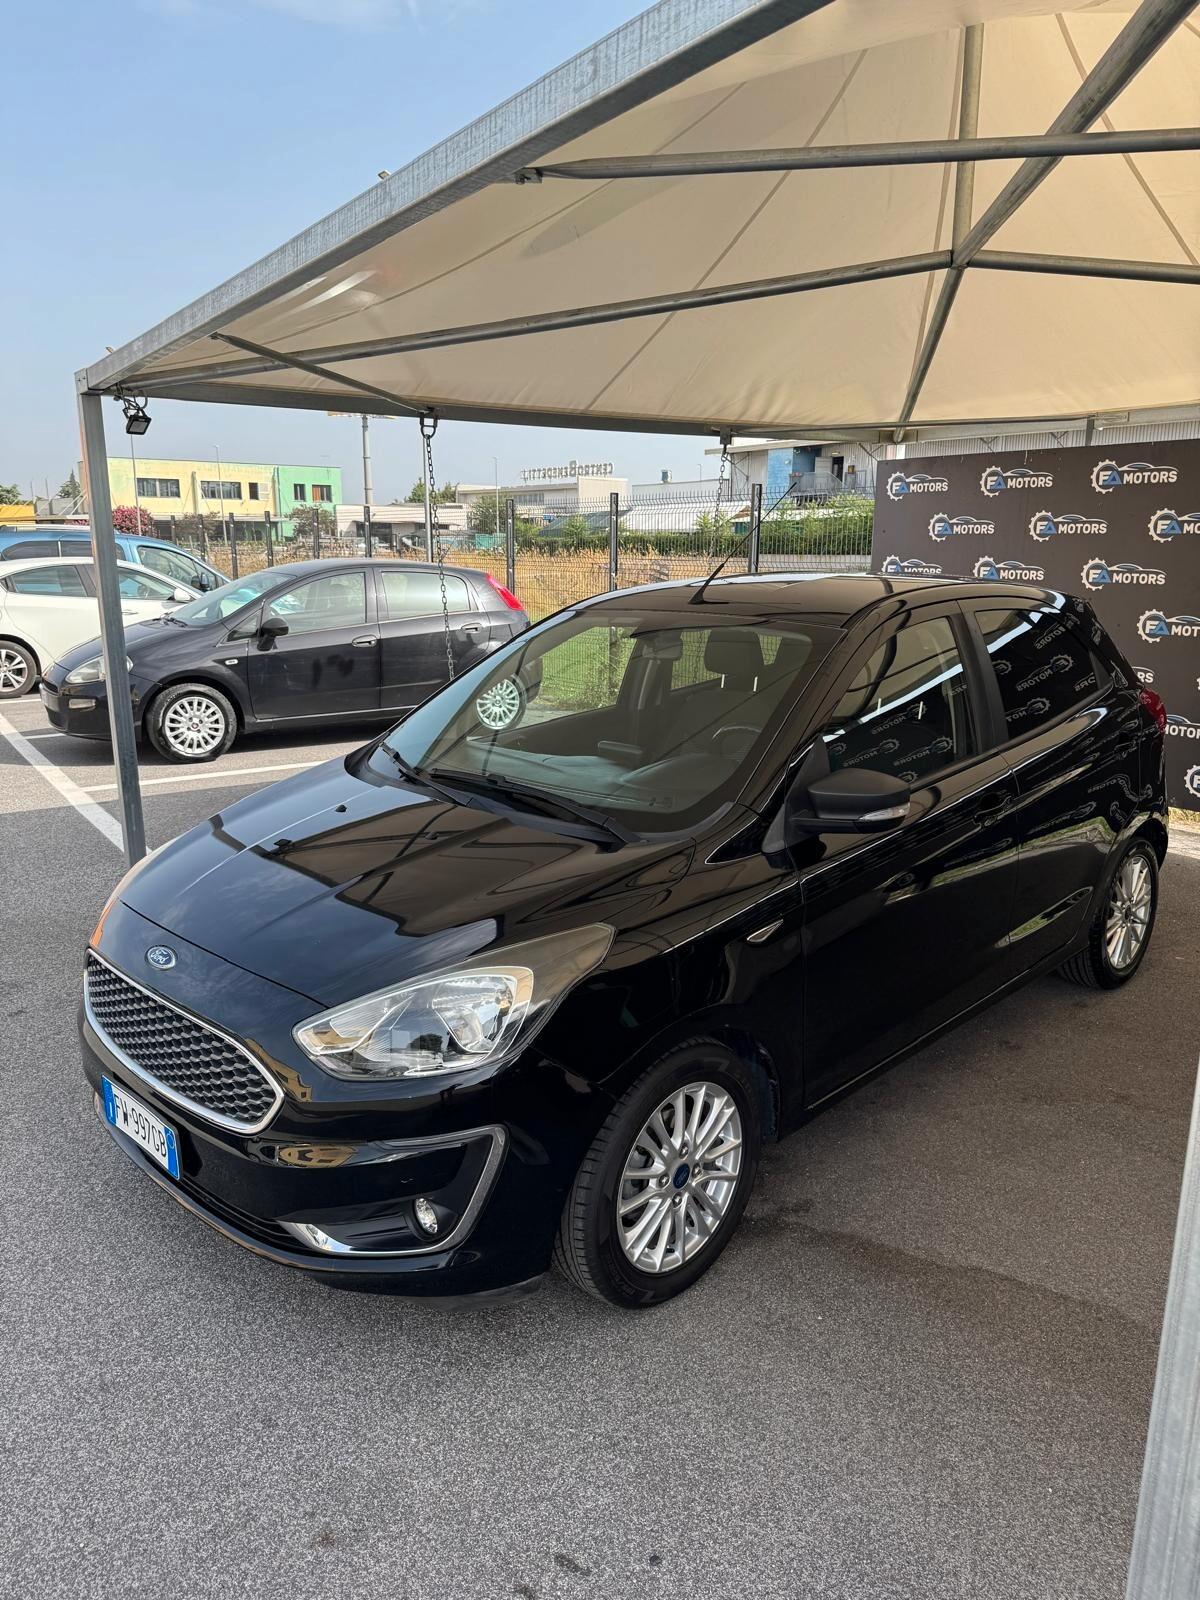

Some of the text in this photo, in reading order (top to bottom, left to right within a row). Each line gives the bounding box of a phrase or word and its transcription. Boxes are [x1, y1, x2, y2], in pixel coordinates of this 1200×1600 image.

[1007, 476, 1053, 489] MOTORS
[1123, 471, 1178, 485] MOTORS
[909, 481, 949, 493] MOTORS
[953, 524, 995, 535] MOTORS
[1058, 523, 1108, 534] MOTORS
[1000, 569, 1045, 581] MOTORS
[1112, 573, 1166, 585] MOTORS
